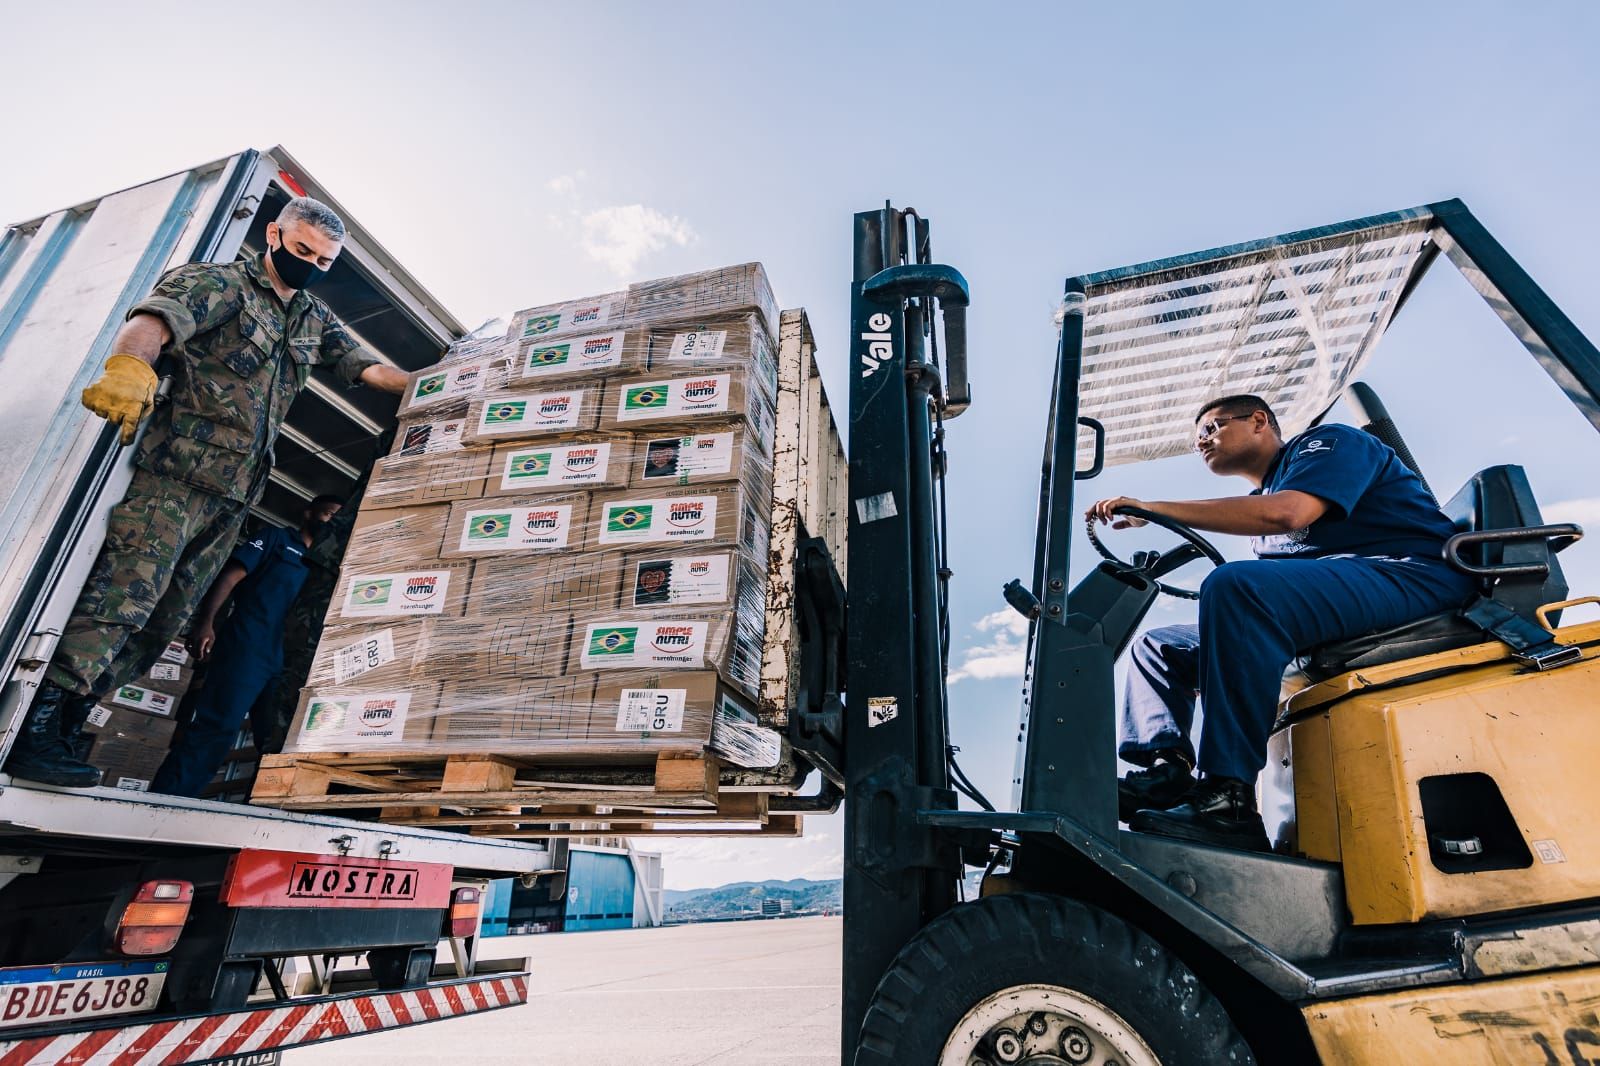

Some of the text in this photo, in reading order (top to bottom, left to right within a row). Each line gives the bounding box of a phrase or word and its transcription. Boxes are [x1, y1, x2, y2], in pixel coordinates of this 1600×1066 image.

[682, 333, 697, 356] GRU
[684, 379, 717, 390] SIMPLE
[685, 388, 715, 397] NUTRI
[540, 396, 571, 406] SIMPLE
[541, 404, 567, 413] NUTRI
[567, 449, 598, 458] SIMPLE
[567, 457, 595, 466] NUTRI
[670, 502, 704, 512] SIMPLE
[527, 510, 559, 520] SIMPLE
[670, 511, 702, 521] NUTRI
[527, 519, 556, 529] NUTRI
[407, 576, 437, 586] SIMPLE
[406, 585, 434, 594] NUTRI
[656, 626, 693, 635] SIMPLE
[655, 636, 690, 645] NUTRI
[367, 639, 379, 668] GRU
[364, 700, 397, 709] SIMPLE
[363, 708, 393, 719] NUTRI
[653, 694, 669, 730] GRU
[296, 868, 411, 895] NOSTRA
[76, 968, 104, 978] BRASIL
[2, 977, 149, 1021] BDE6J88
